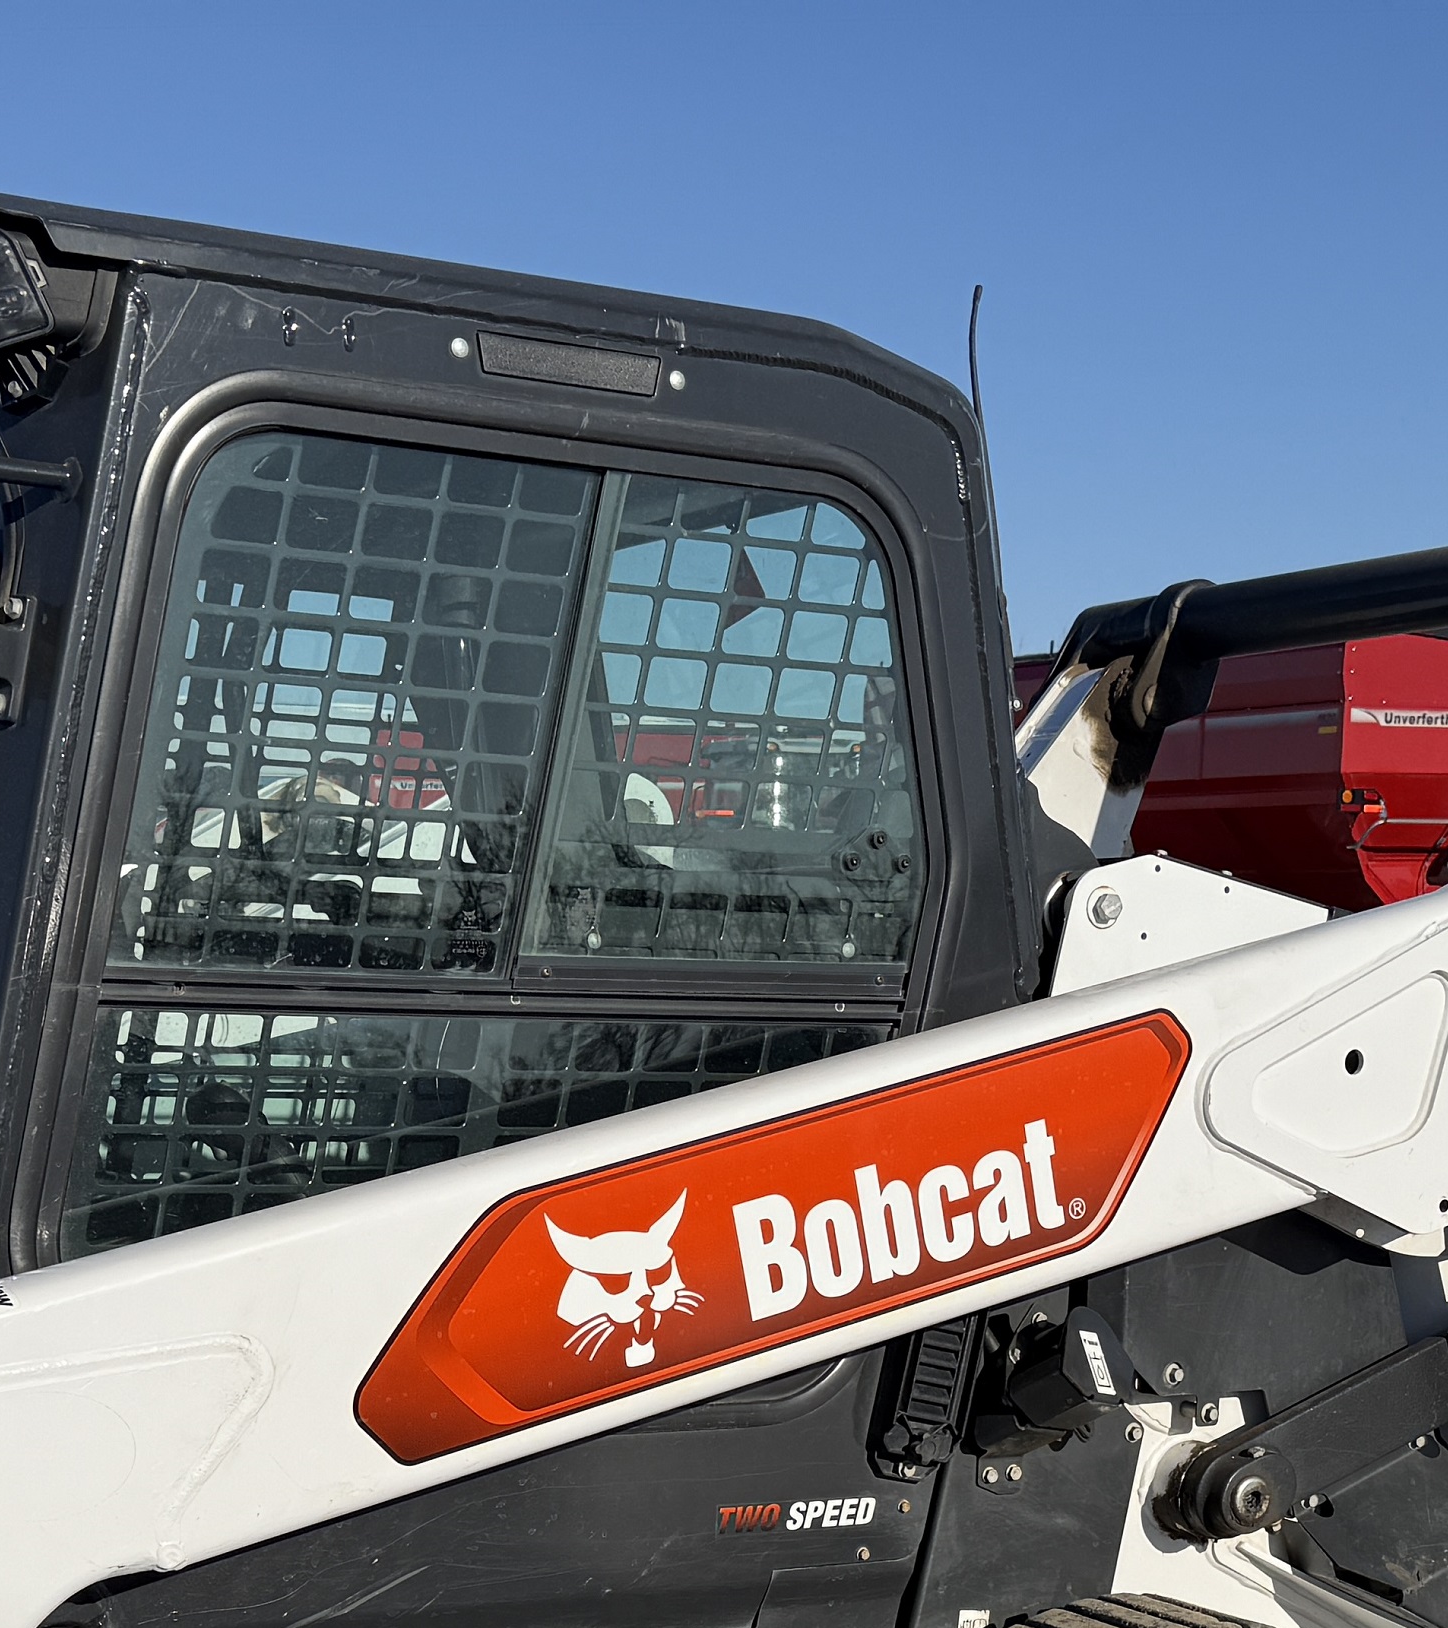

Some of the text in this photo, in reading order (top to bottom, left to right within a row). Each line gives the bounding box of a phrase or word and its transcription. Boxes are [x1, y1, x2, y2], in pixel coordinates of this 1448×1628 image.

[731, 1117, 1067, 1323] Bobcat
[718, 1497, 877, 1535] TWO SPEED
